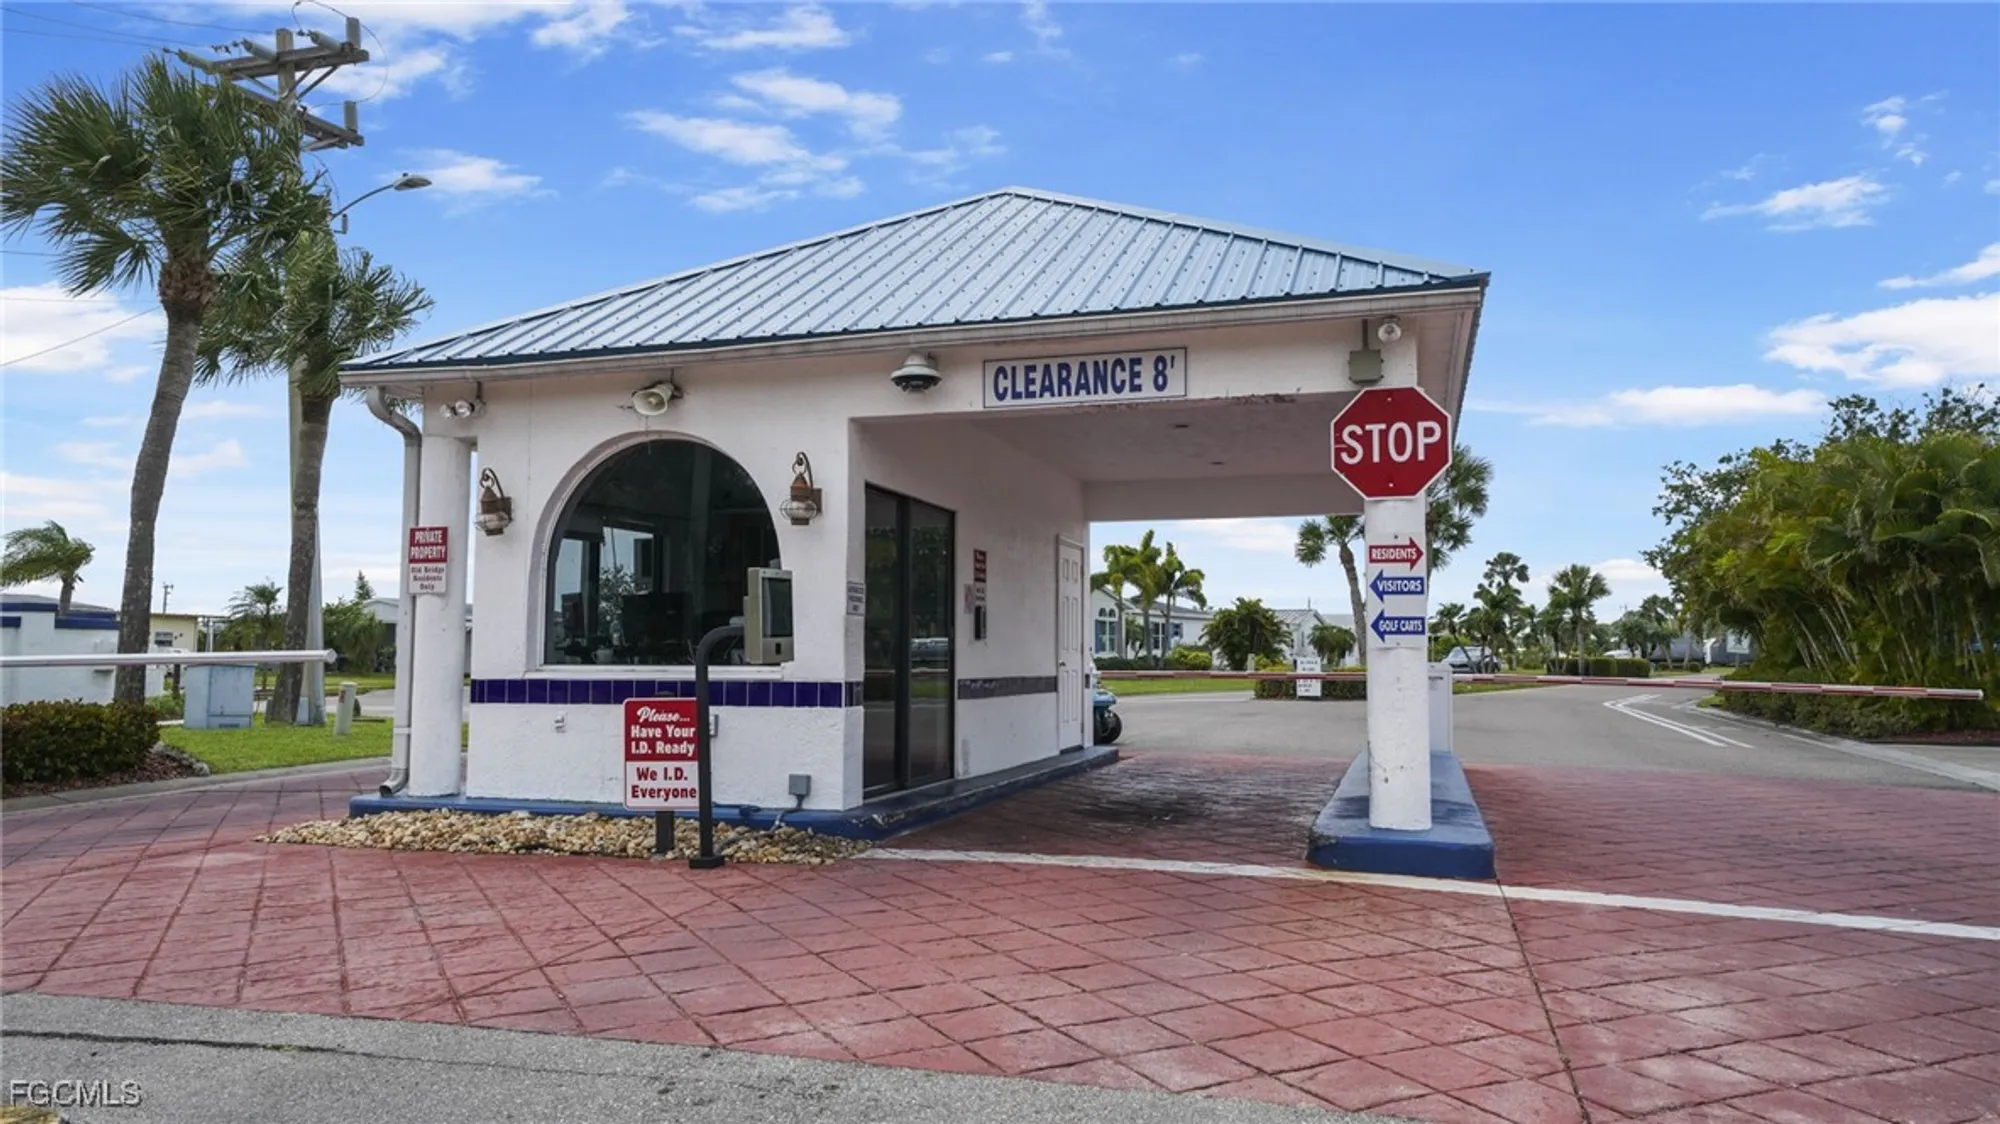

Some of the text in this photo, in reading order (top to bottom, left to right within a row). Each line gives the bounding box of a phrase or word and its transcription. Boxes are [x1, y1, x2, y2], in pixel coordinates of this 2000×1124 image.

[994, 355, 1176, 401] CLEARANCE 8'
[1340, 421, 1442, 464] STOP
[415, 530, 443, 544] PRIVATE
[410, 545, 446, 559] PROPERTY
[1371, 547, 1418, 560] RESIDENTS
[1377, 580, 1422, 592] VISITORS
[1379, 619, 1422, 632] GOLF CARTS
[636, 705, 691, 723] Please...
[631, 724, 696, 738] Have Your
[631, 740, 695, 757] I.D. Ready
[636, 767, 688, 781] We I.D.
[631, 784, 697, 802] Everyone
